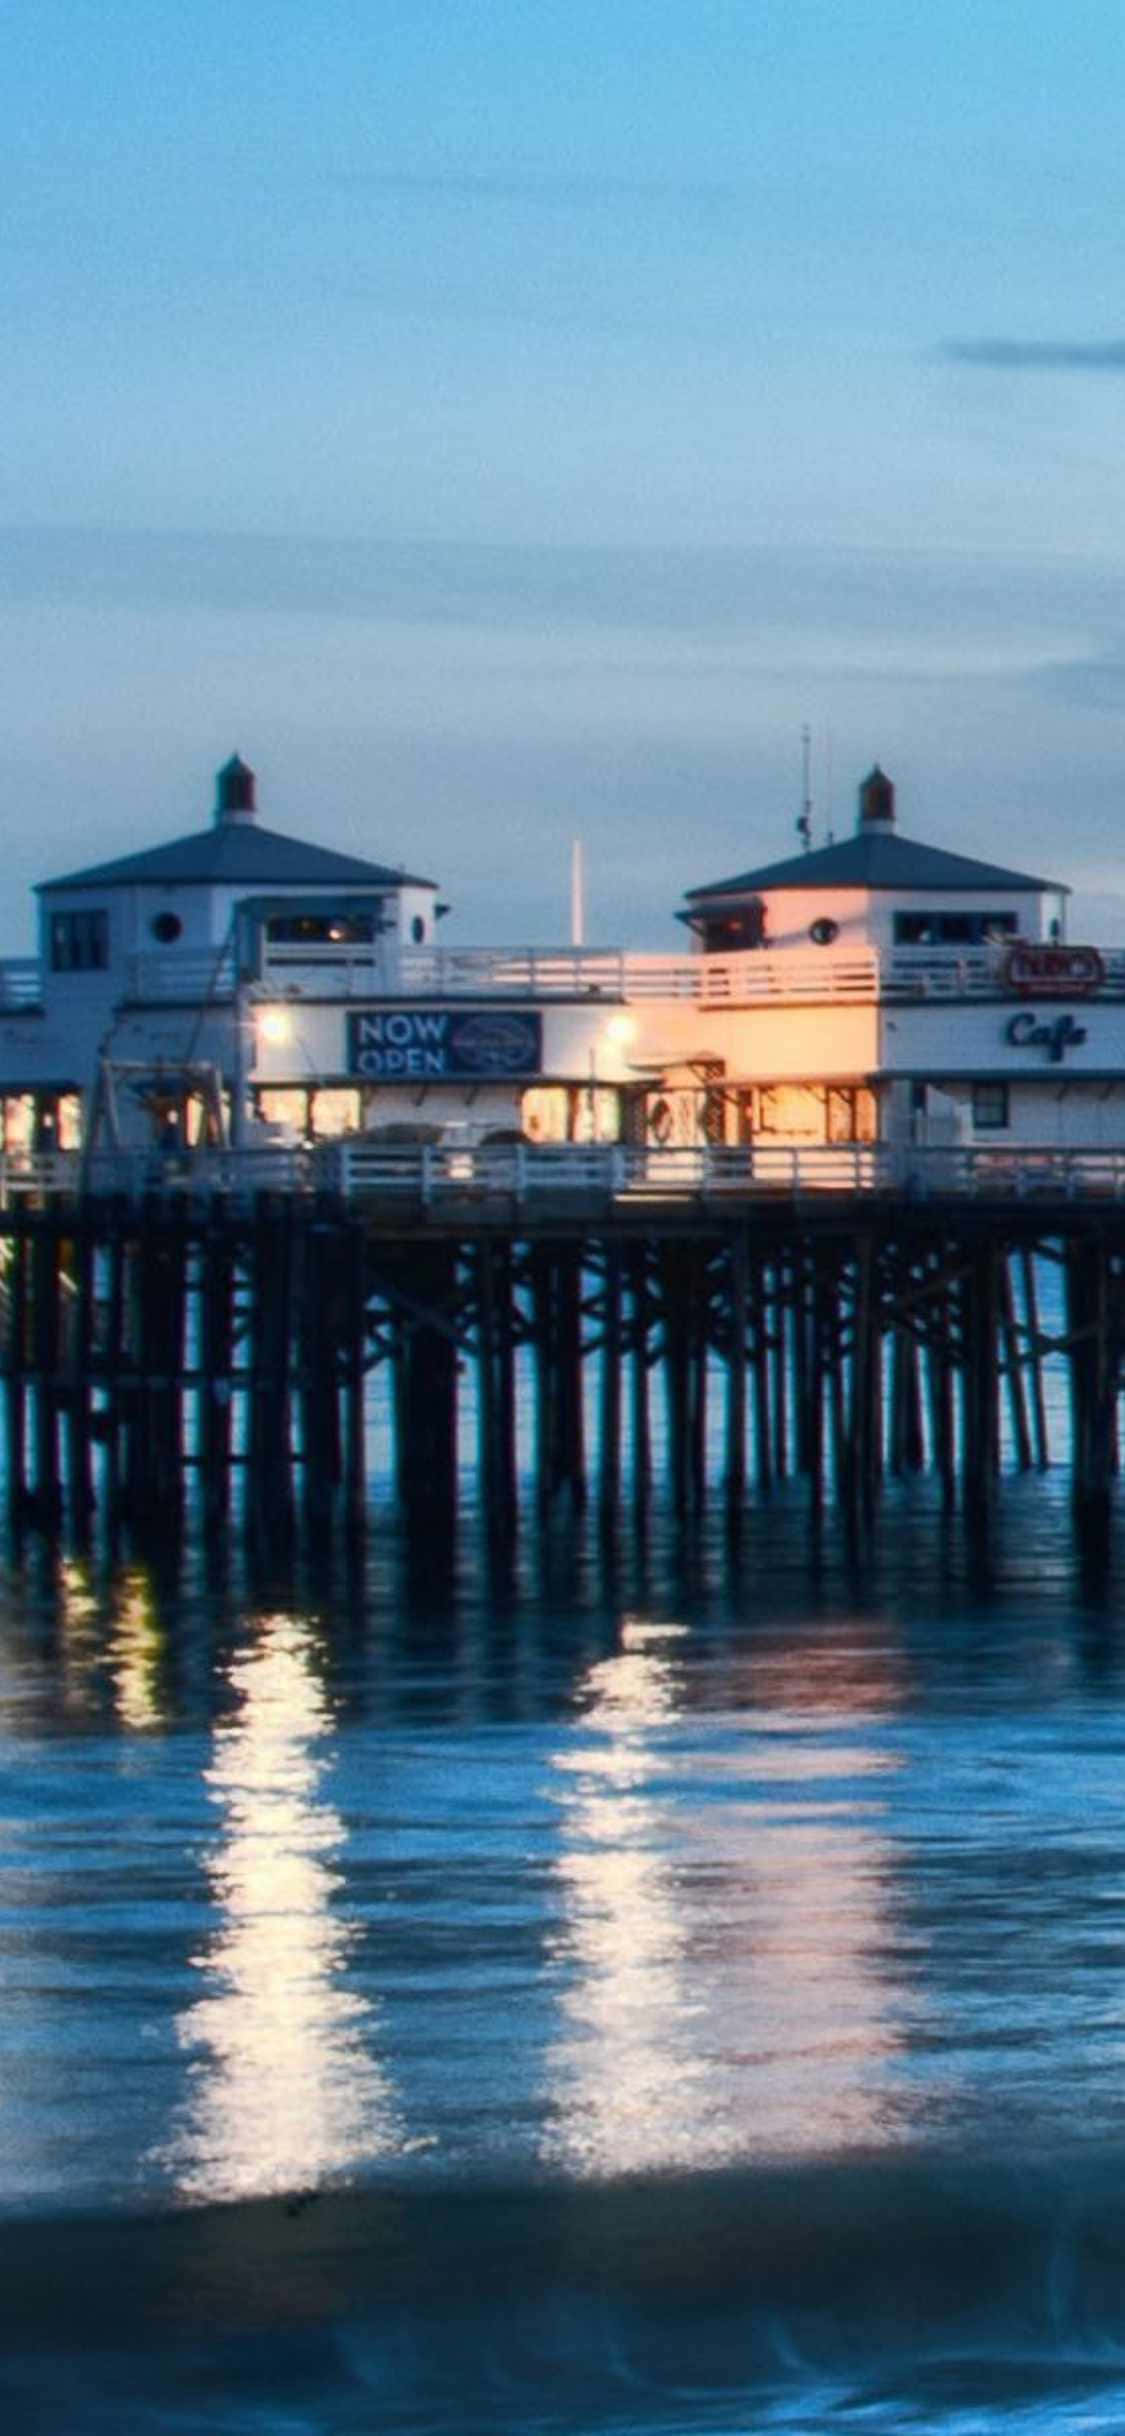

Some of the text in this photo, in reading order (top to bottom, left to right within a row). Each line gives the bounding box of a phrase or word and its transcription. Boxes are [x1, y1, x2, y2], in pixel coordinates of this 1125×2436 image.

[358, 1013, 448, 1044] NOW
[1005, 1012, 1087, 1062] Cafe
[357, 1048, 445, 1073] OPEN
